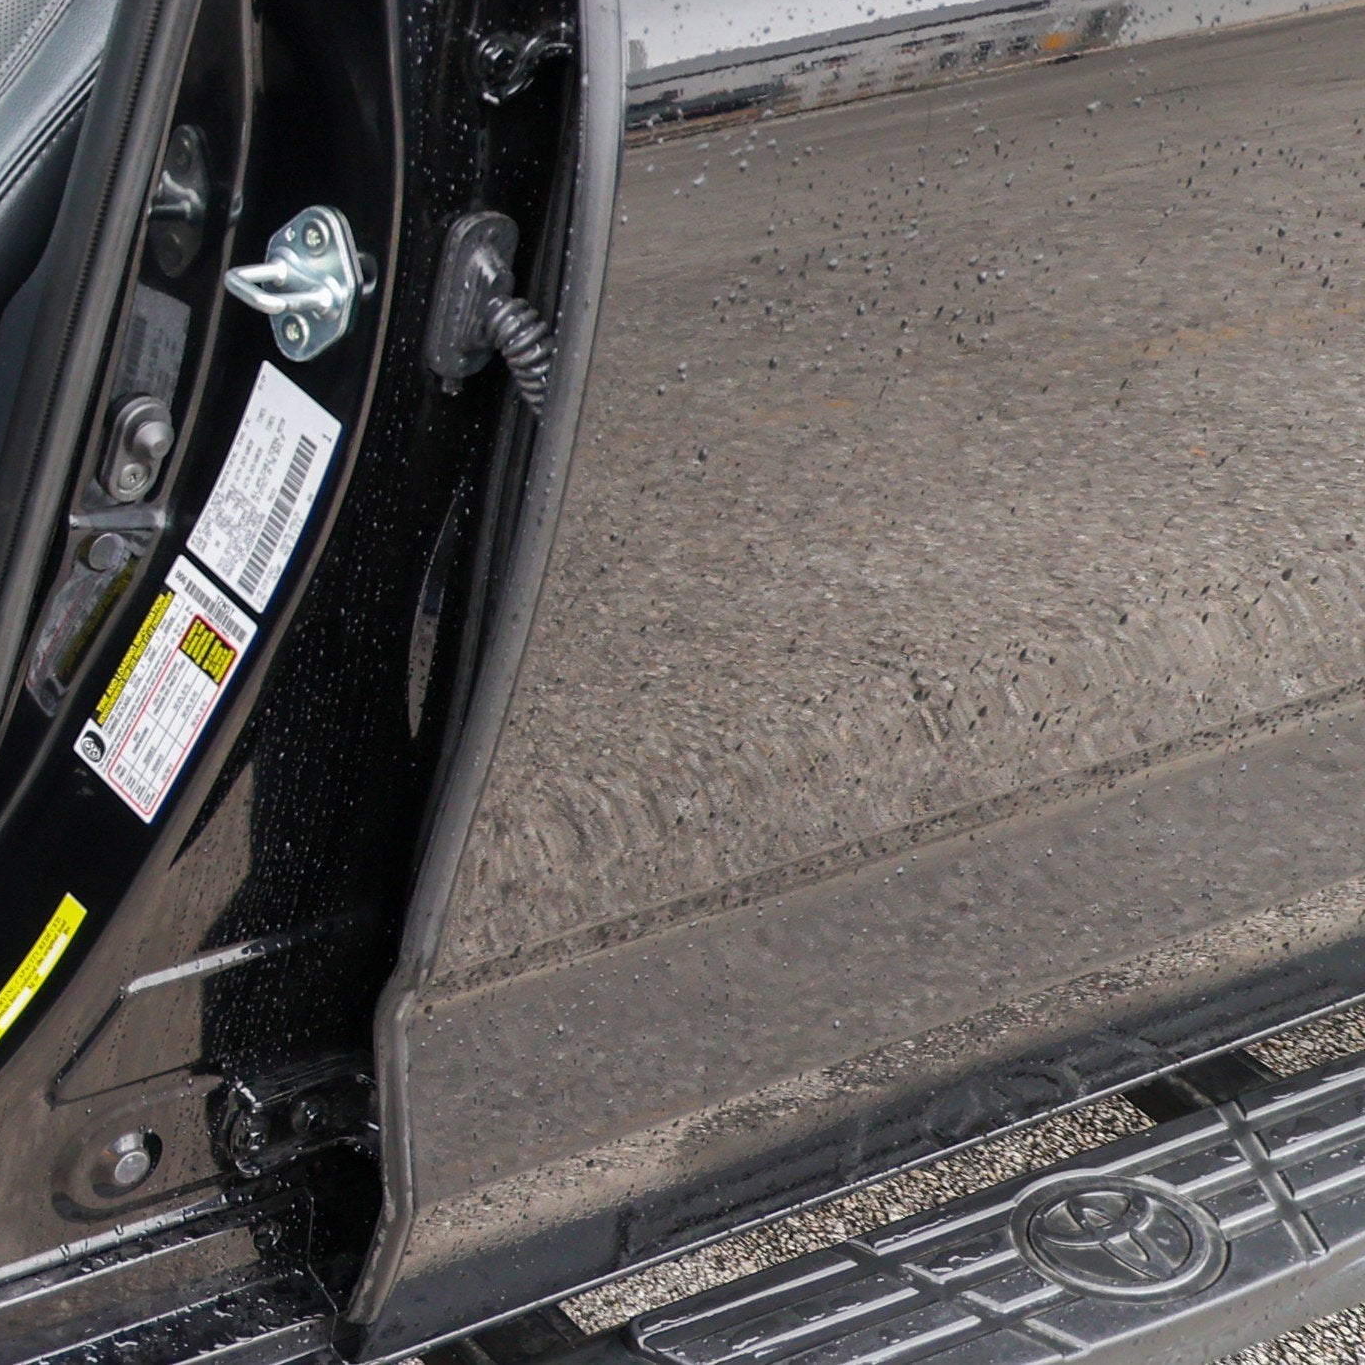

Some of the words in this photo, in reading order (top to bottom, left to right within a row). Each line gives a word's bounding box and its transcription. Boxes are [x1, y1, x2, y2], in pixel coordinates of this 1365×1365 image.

[104, 676, 119, 696] AND
[113, 643, 137, 680] LOADING
[131, 592, 166, 647] INFORMATION
